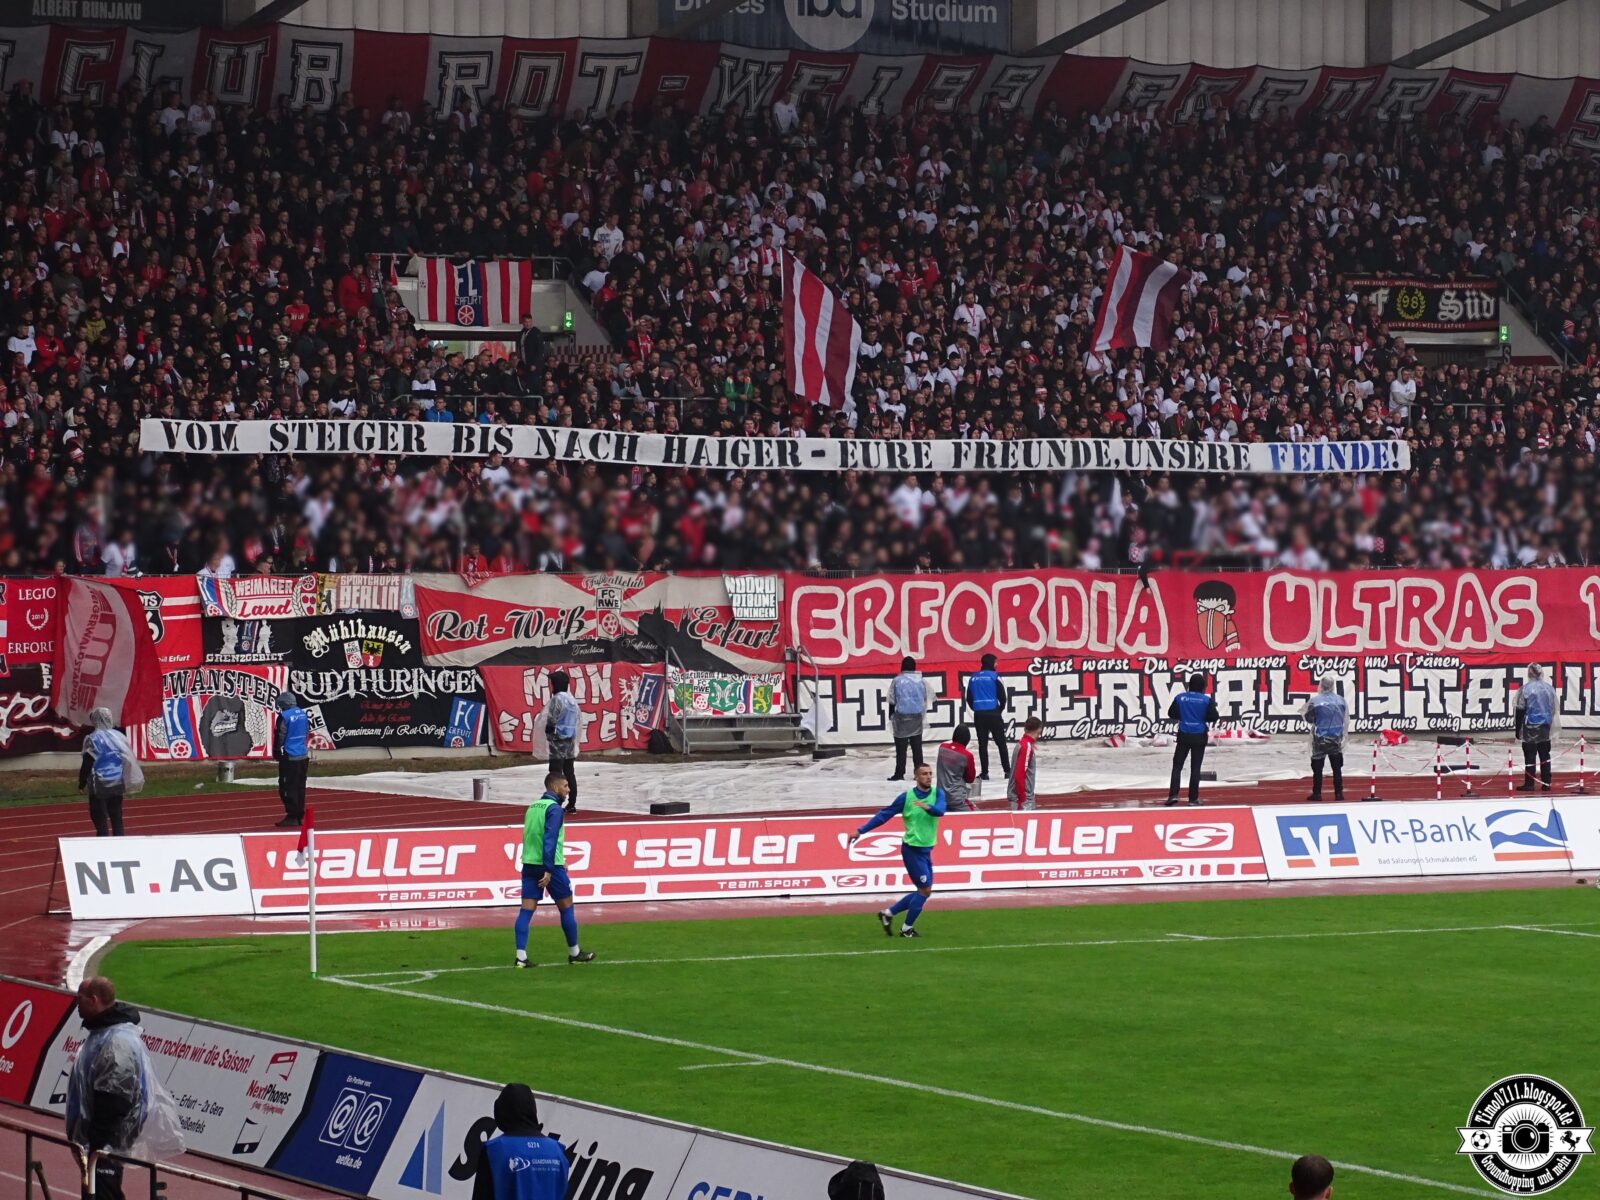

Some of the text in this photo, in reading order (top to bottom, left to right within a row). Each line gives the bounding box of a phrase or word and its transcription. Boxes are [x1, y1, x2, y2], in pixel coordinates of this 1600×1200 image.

[32, 0, 77, 17] ALBERT
[1402, 295, 1419, 309] 98
[1437, 288, 1496, 322] Süd
[160, 420, 239, 452] VOM
[270, 422, 427, 453] STEIGER
[452, 424, 513, 455] BIS
[535, 428, 640, 463] NACH
[663, 435, 802, 468] HAIGER
[838, 440, 933, 469] EURE
[1269, 440, 1401, 472] FEINDE!
[235, 578, 293, 597] WEIMARER
[340, 575, 399, 586] SPORTGRUPPE
[724, 576, 776, 594] NOORD
[18, 586, 57, 601] LEGIO
[341, 585, 399, 610] BERLIN
[598, 599, 620, 608] RWE
[601, 589, 616, 599] FC
[238, 600, 294, 618] Land
[791, 577, 1169, 665] ERFORDIA
[1264, 572, 1544, 652] ULTRAS
[303, 618, 412, 658] Mühlhausen
[687, 606, 780, 649] Erfurt
[205, 653, 284, 664] GRENZGEBIET
[1028, 656, 1073, 675] Einst
[1082, 657, 1130, 672] warst
[1137, 656, 1168, 674] Du
[1236, 655, 1287, 669] unserer
[1299, 654, 1356, 675] Erfolge
[1364, 655, 1388, 668] und
[1393, 652, 1466, 673] Tränen,
[331, 725, 381, 741] Gemeinsam
[381, 725, 394, 739] für
[1072, 716, 1125, 739] Glanz
[1241, 712, 1286, 731] Tage
[1356, 717, 1383, 731] wir
[1392, 717, 1417, 730] uns
[1429, 714, 1461, 732] ewig
[1358, 814, 1482, 845] VR-Bank
[74, 858, 239, 896] NT.AG
[161, 1036, 191, 1060] rocken
[204, 1044, 220, 1066] die
[218, 1048, 256, 1074] Saison!
[178, 1094, 199, 1111] Erfurt
[246, 1079, 292, 1105] NextPhones
